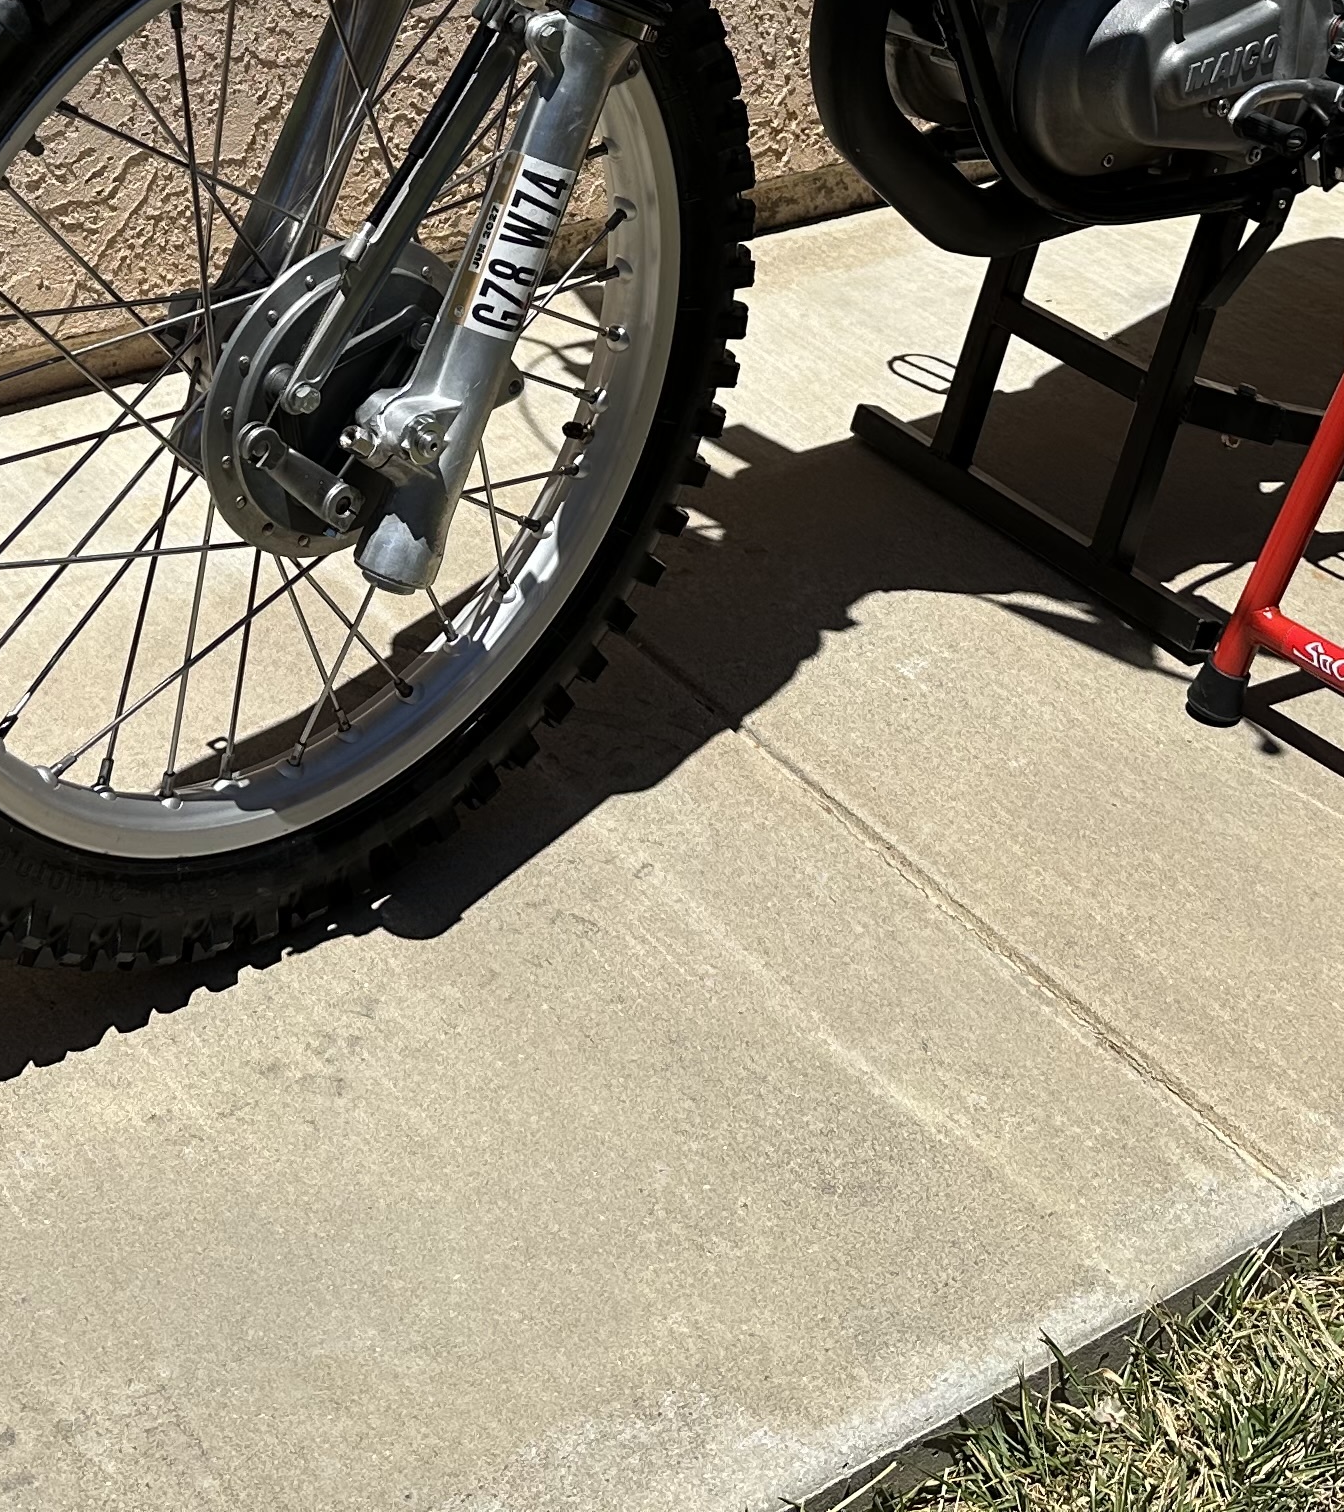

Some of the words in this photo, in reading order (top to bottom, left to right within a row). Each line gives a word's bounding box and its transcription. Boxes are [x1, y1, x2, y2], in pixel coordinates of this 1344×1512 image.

[471, 243, 487, 270] JUN
[482, 204, 500, 240] 2027
[498, 168, 569, 250] W74
